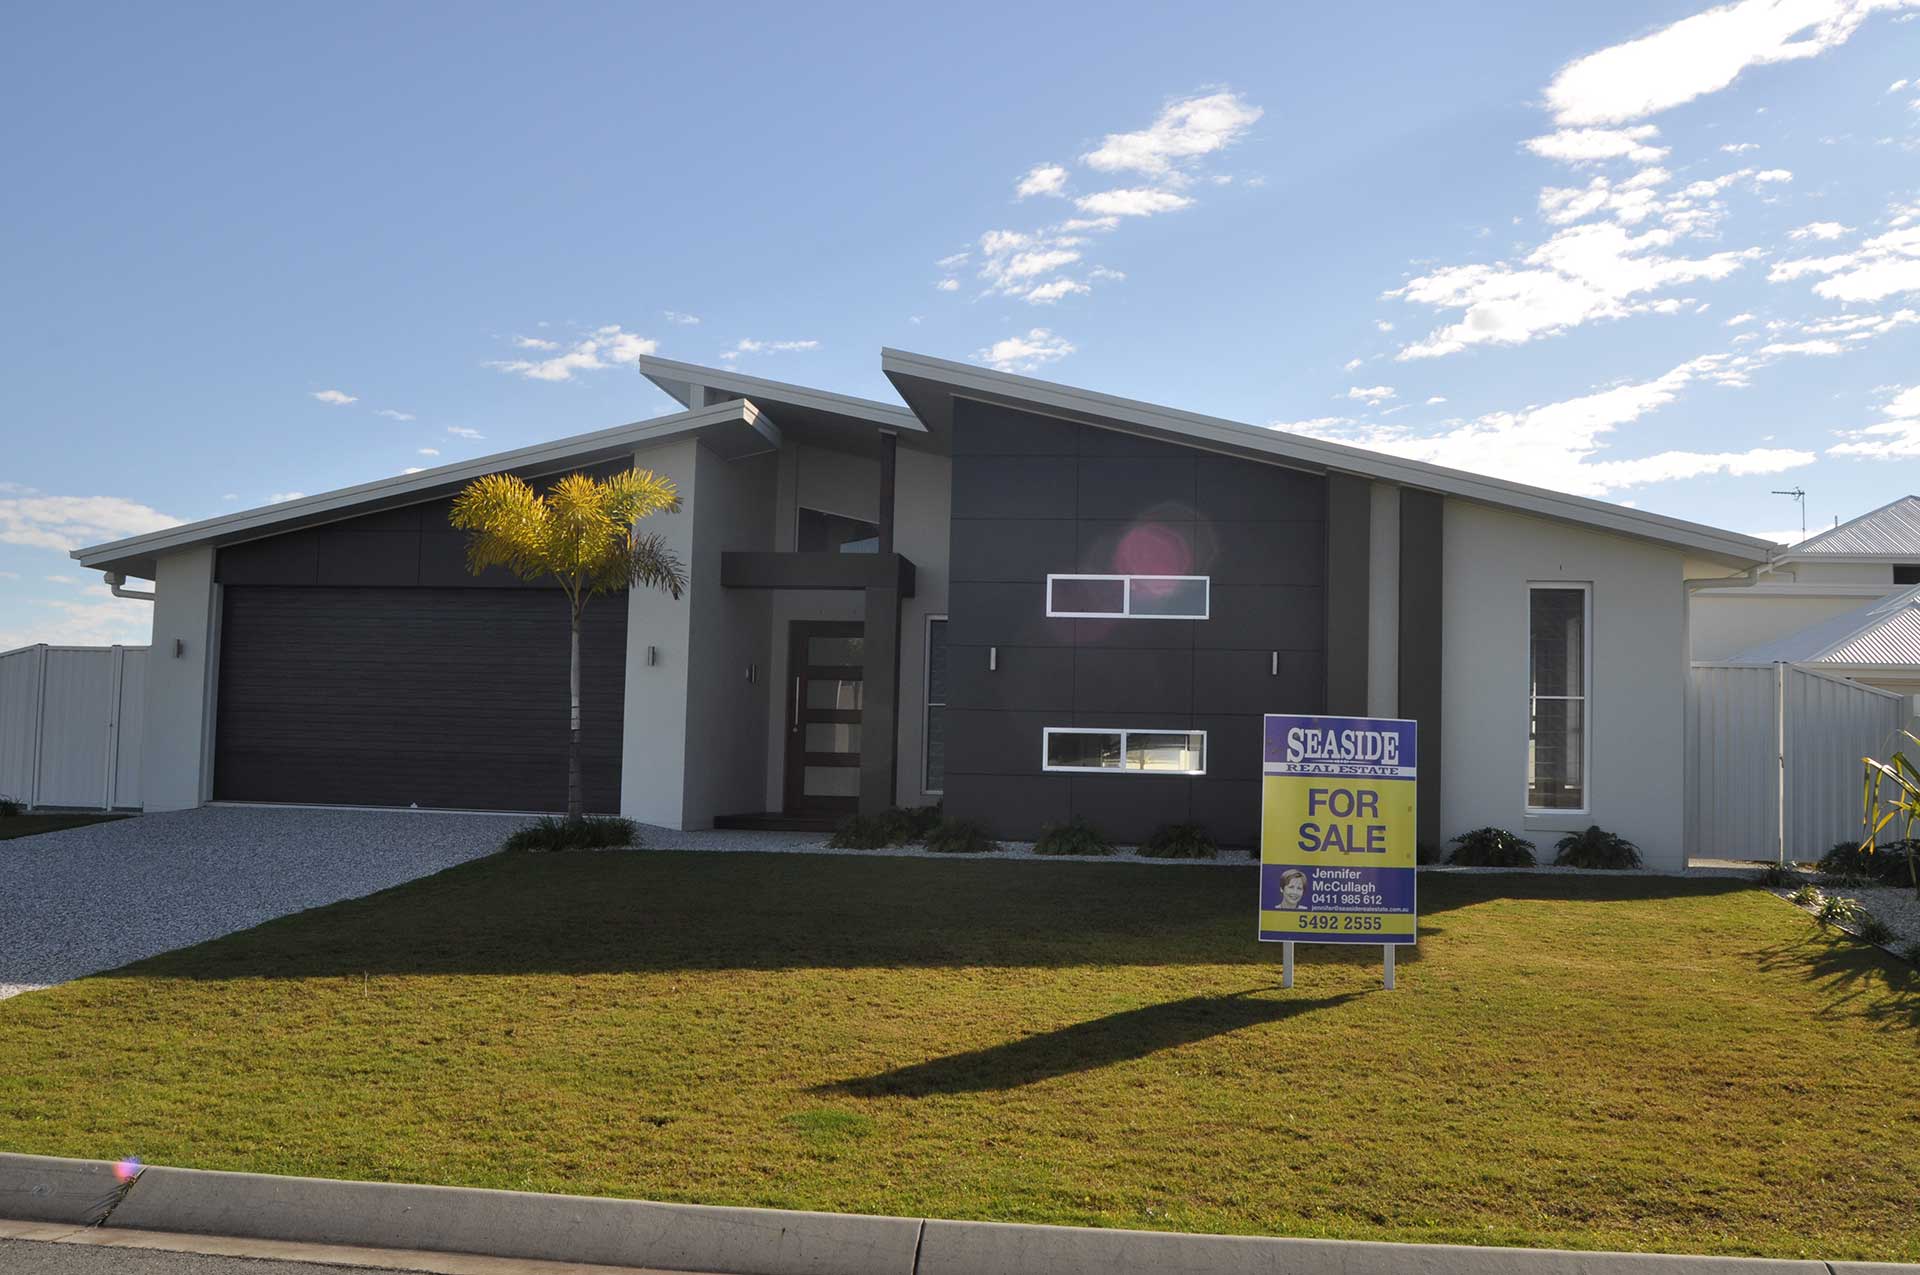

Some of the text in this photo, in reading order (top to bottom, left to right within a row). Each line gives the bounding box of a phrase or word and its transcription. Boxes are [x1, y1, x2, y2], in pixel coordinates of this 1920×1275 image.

[1286, 727, 1399, 765] SEASIDE
[1286, 764, 1399, 775] REAL ESTATE
[1308, 788, 1379, 818] FOR
[1298, 823, 1386, 853] SALE
[1312, 868, 1361, 880] Jennifer
[1312, 881, 1376, 895] McCullagh
[1312, 894, 1382, 905] 0411 985 612
[1298, 915, 1382, 930] 5492 2555
